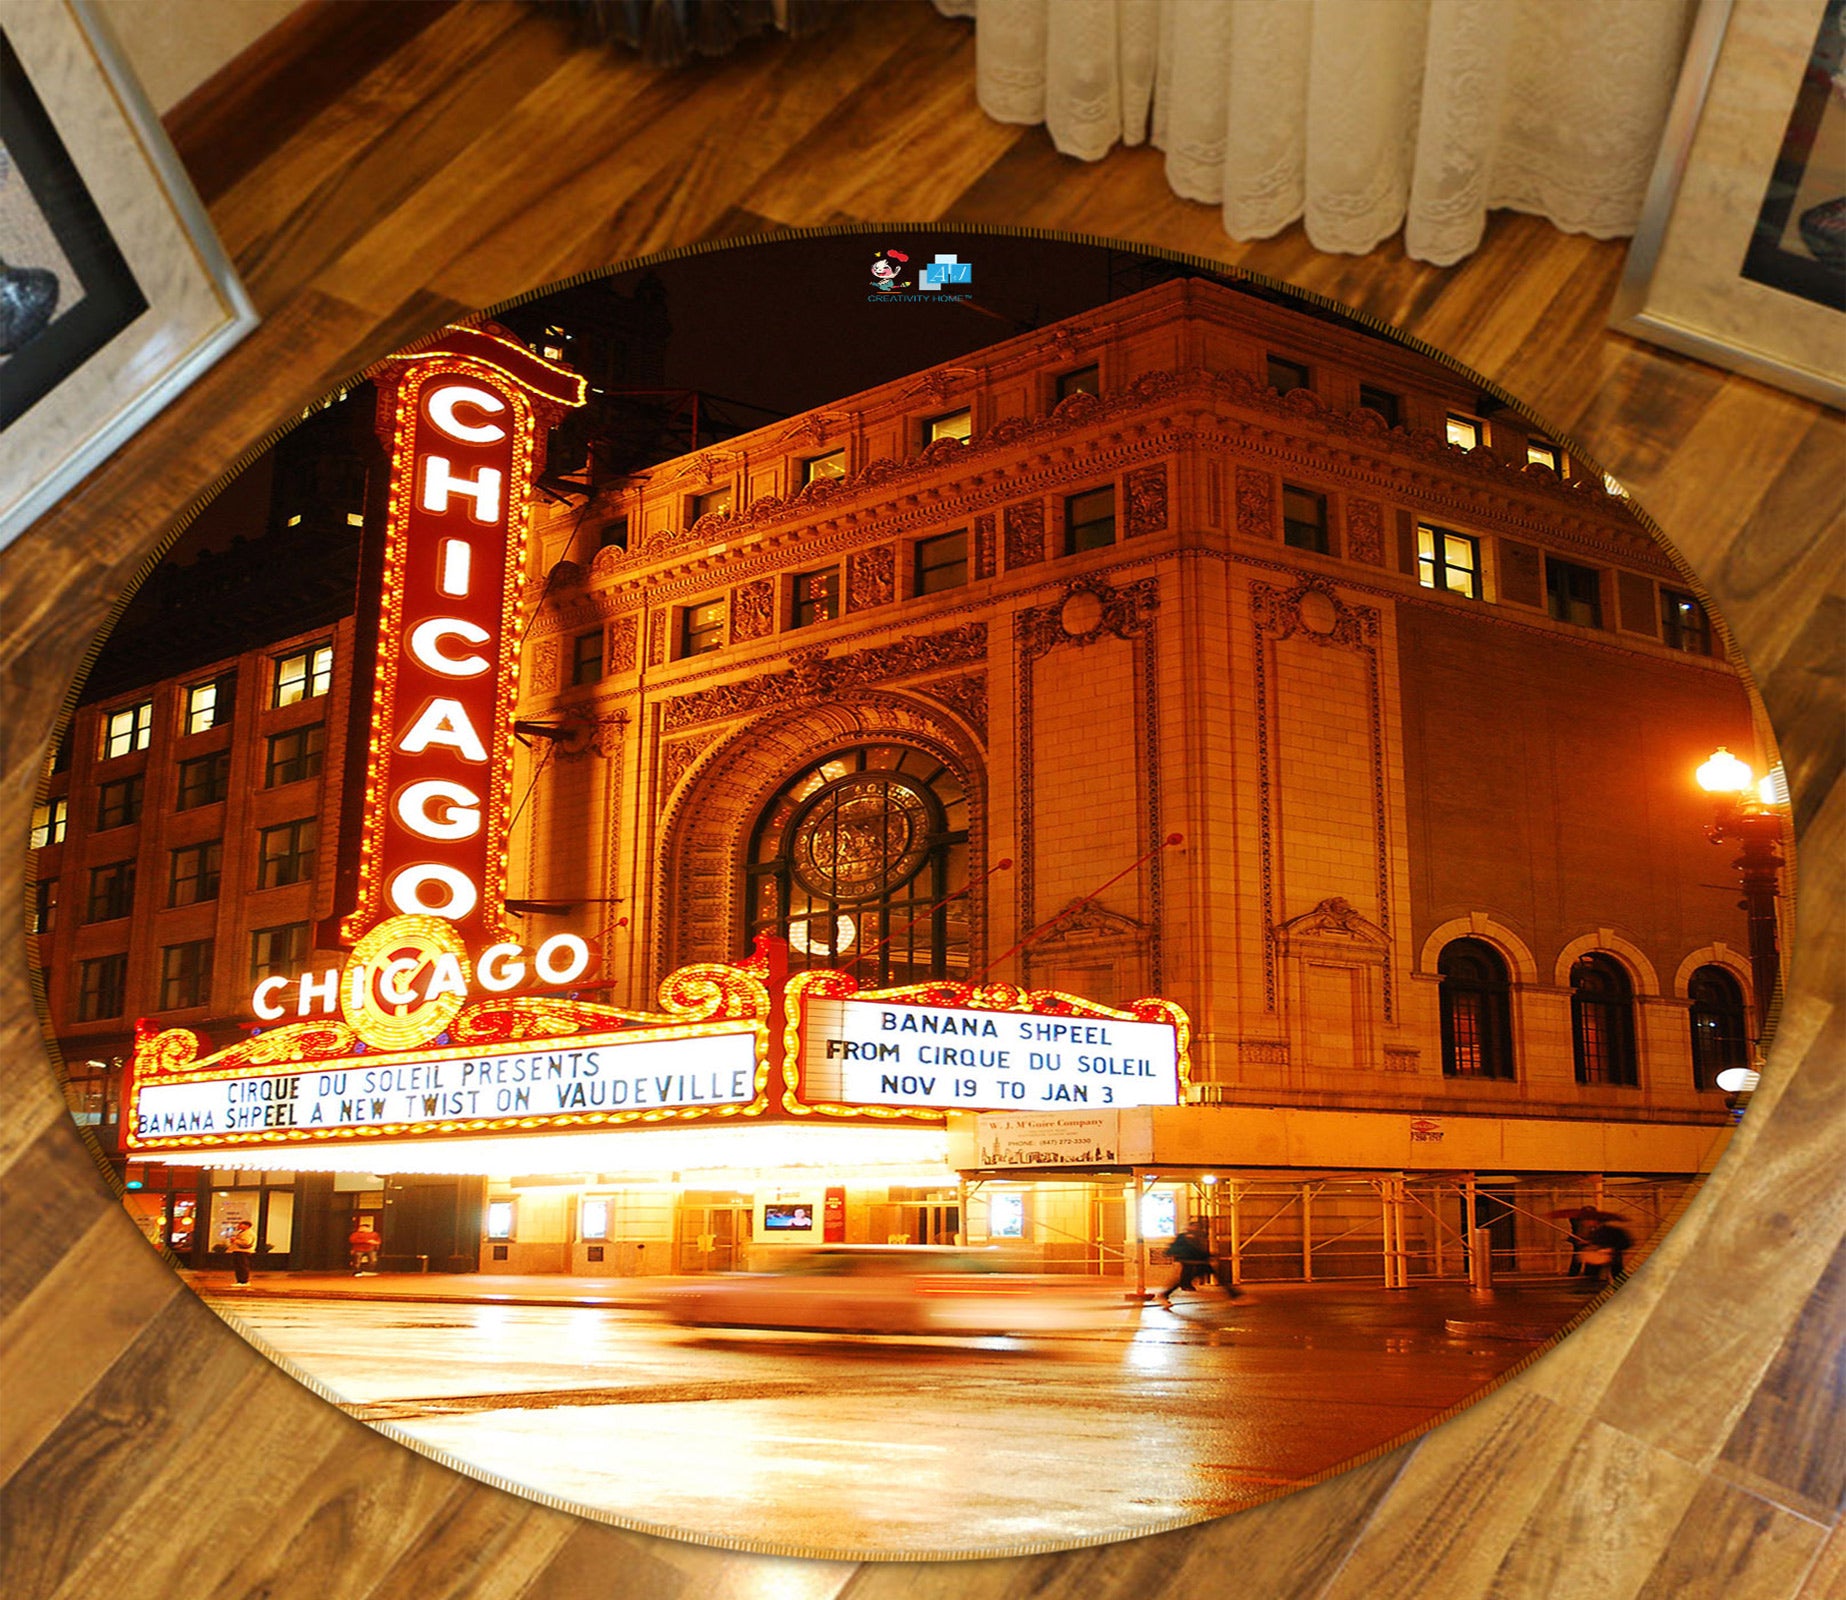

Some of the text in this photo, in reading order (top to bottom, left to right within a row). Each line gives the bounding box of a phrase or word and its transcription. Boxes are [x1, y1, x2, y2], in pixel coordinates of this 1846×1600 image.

[391, 386, 505, 921] CHICAGO
[252, 933, 588, 1021] CHICAGO
[880, 1011, 1112, 1046] BANANA SHPEEL
[228, 1052, 600, 1104] CIRQUE DU SOLEIL PRESENTS
[826, 1039, 1156, 1077] FROM CIRQUE DU SOLEIL
[138, 1070, 747, 1134] BANANA SHPEEL A NEW TWIST ON VAUDEVILLE
[881, 1074, 1113, 1103] NOV 19 TO JAN 3
[1057, 1118, 1104, 1129] Company
